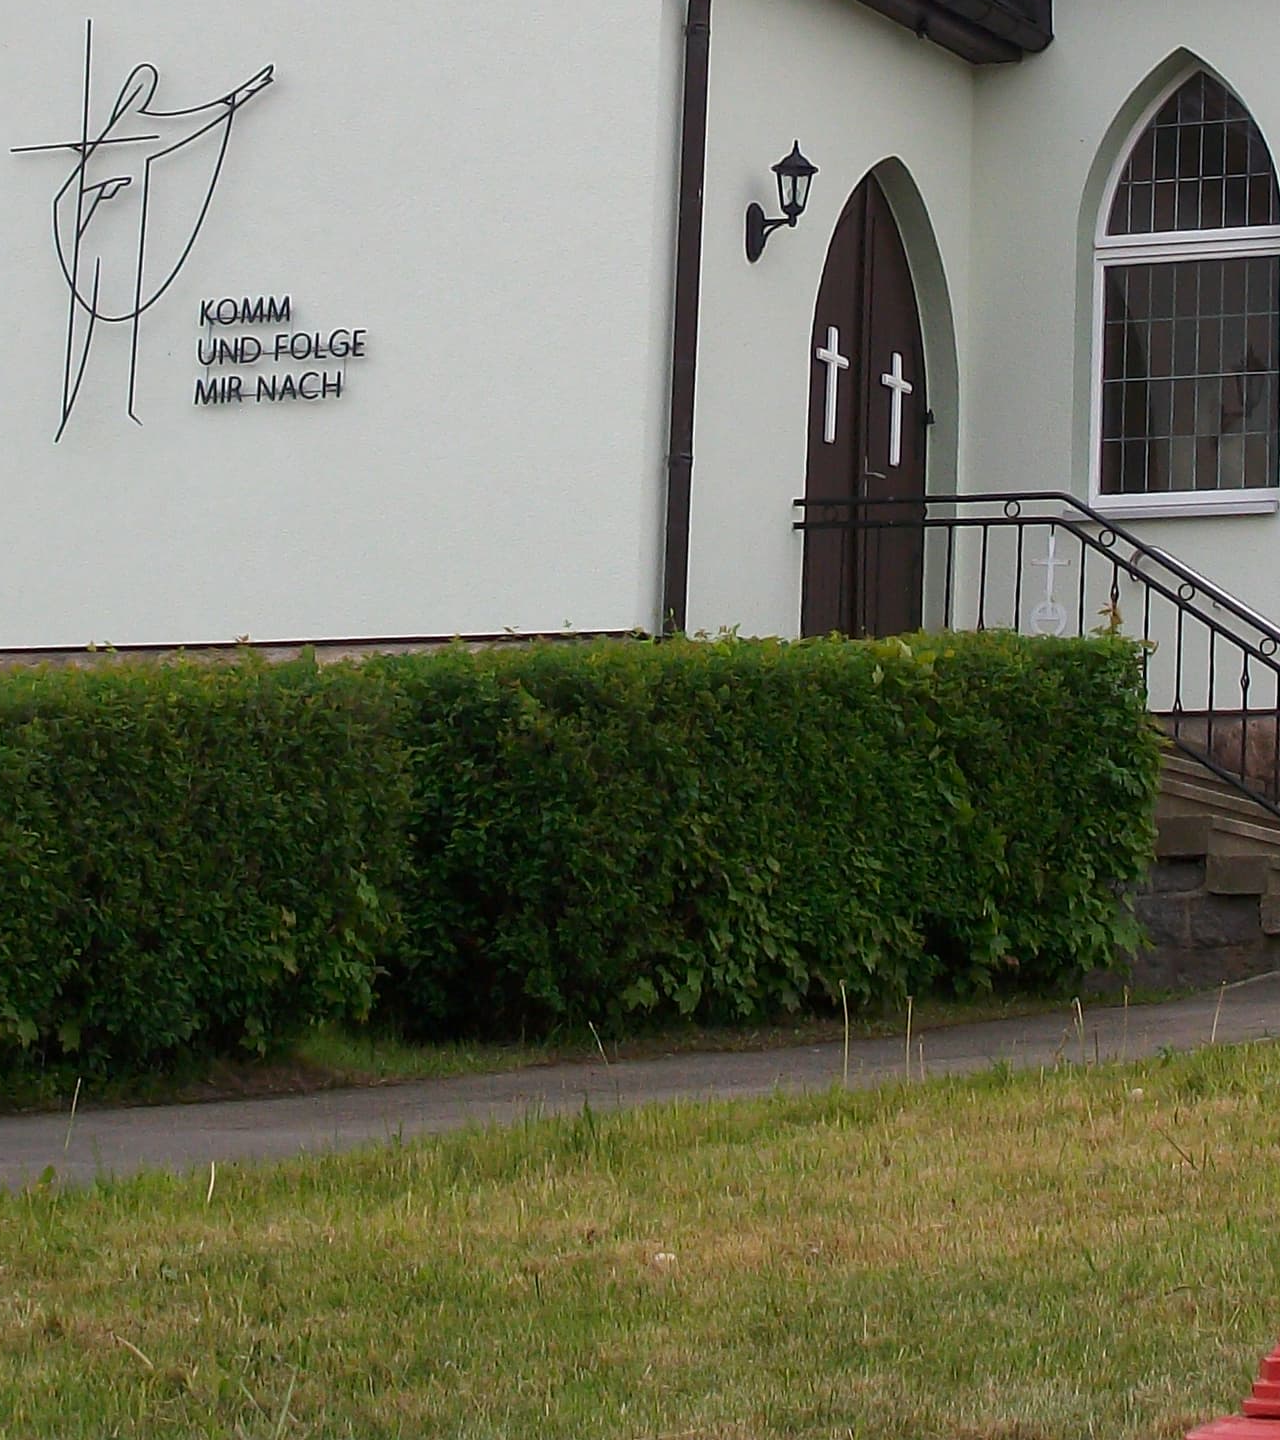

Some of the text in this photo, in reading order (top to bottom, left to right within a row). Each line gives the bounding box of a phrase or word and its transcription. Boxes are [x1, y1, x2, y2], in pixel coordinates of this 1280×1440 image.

[199, 295, 291, 326] KOMM
[197, 328, 367, 366] UND FOLGE
[194, 371, 341, 405] MIR NACH
